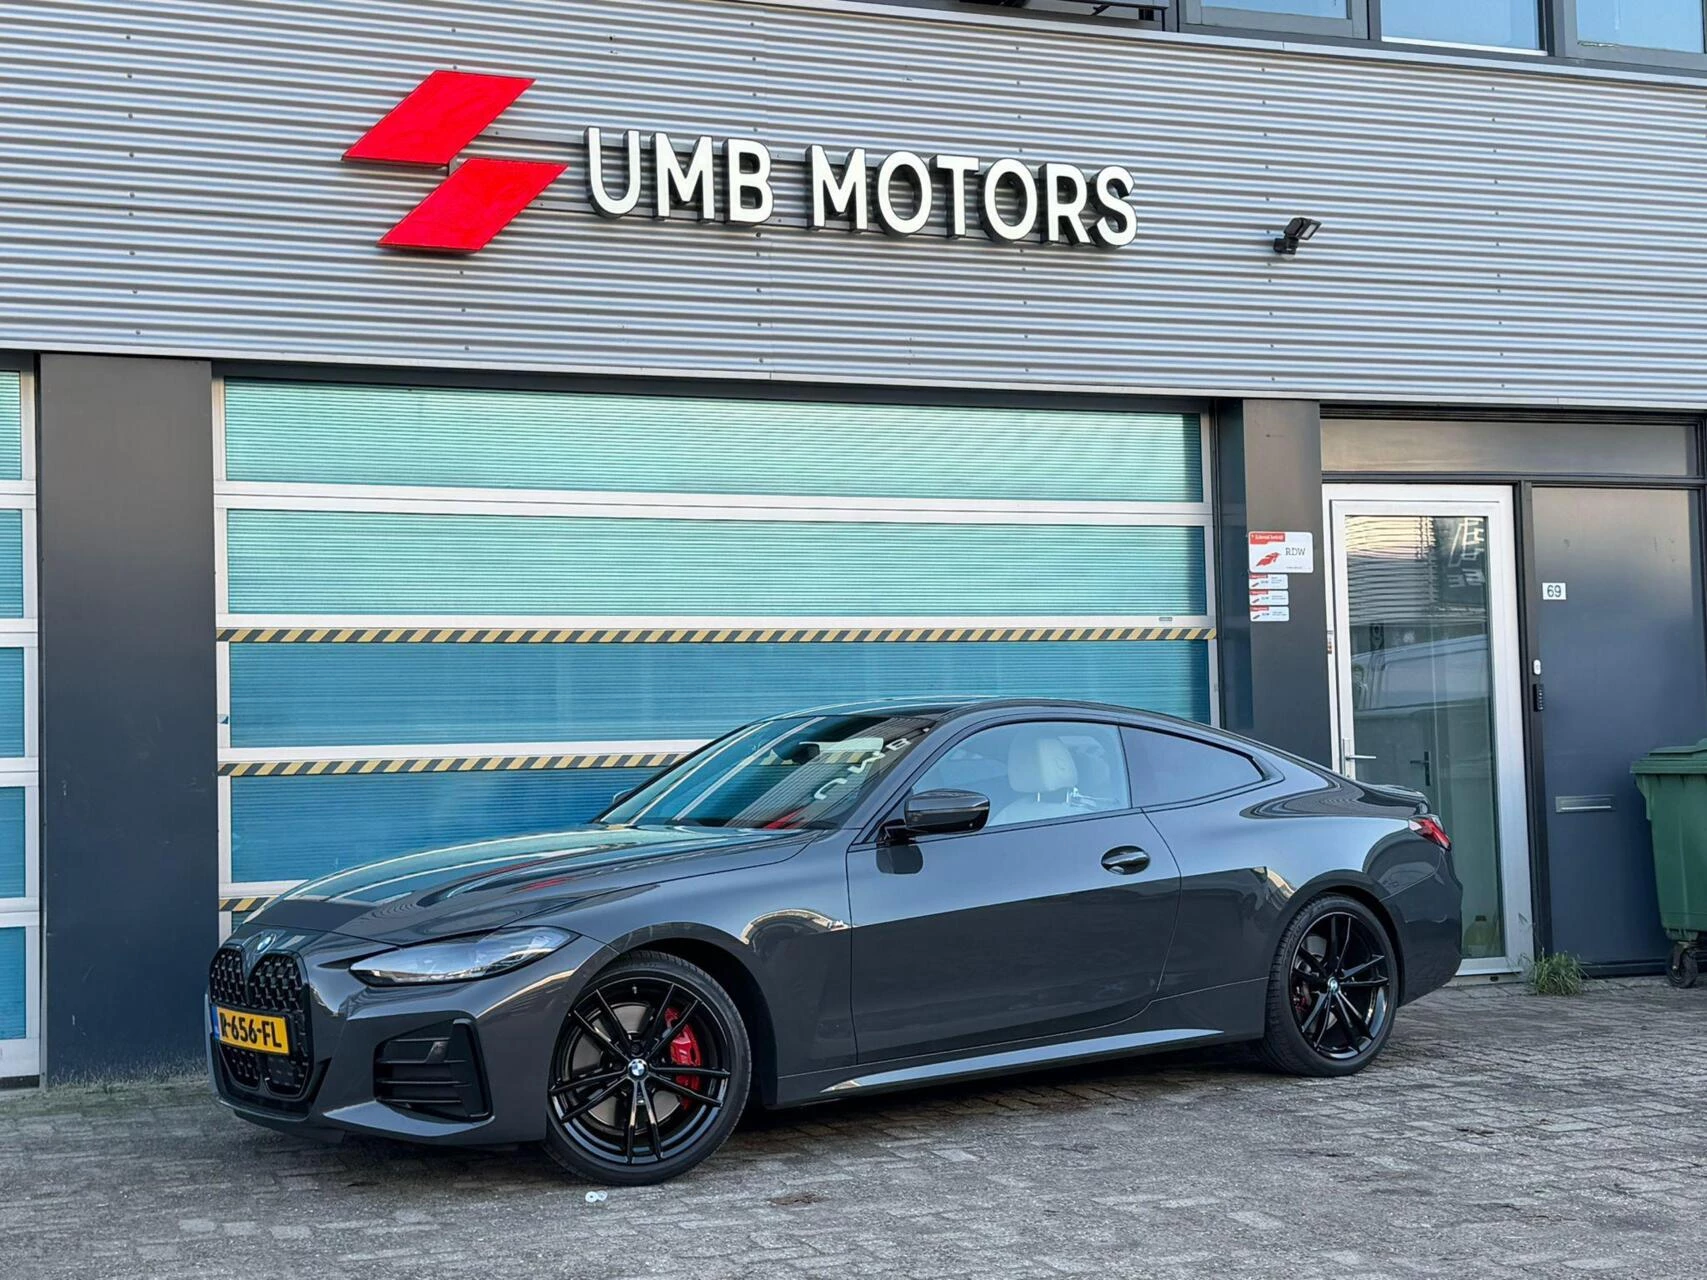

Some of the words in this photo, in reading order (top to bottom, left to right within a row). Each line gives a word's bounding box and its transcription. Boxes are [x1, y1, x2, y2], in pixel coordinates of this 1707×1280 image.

[585, 126, 774, 223] UMB
[806, 145, 1138, 247] MOTORS
[1285, 547, 1306, 556] RDW
[1547, 584, 1561, 598] 69
[219, 1012, 282, 1048] R-656-FL
